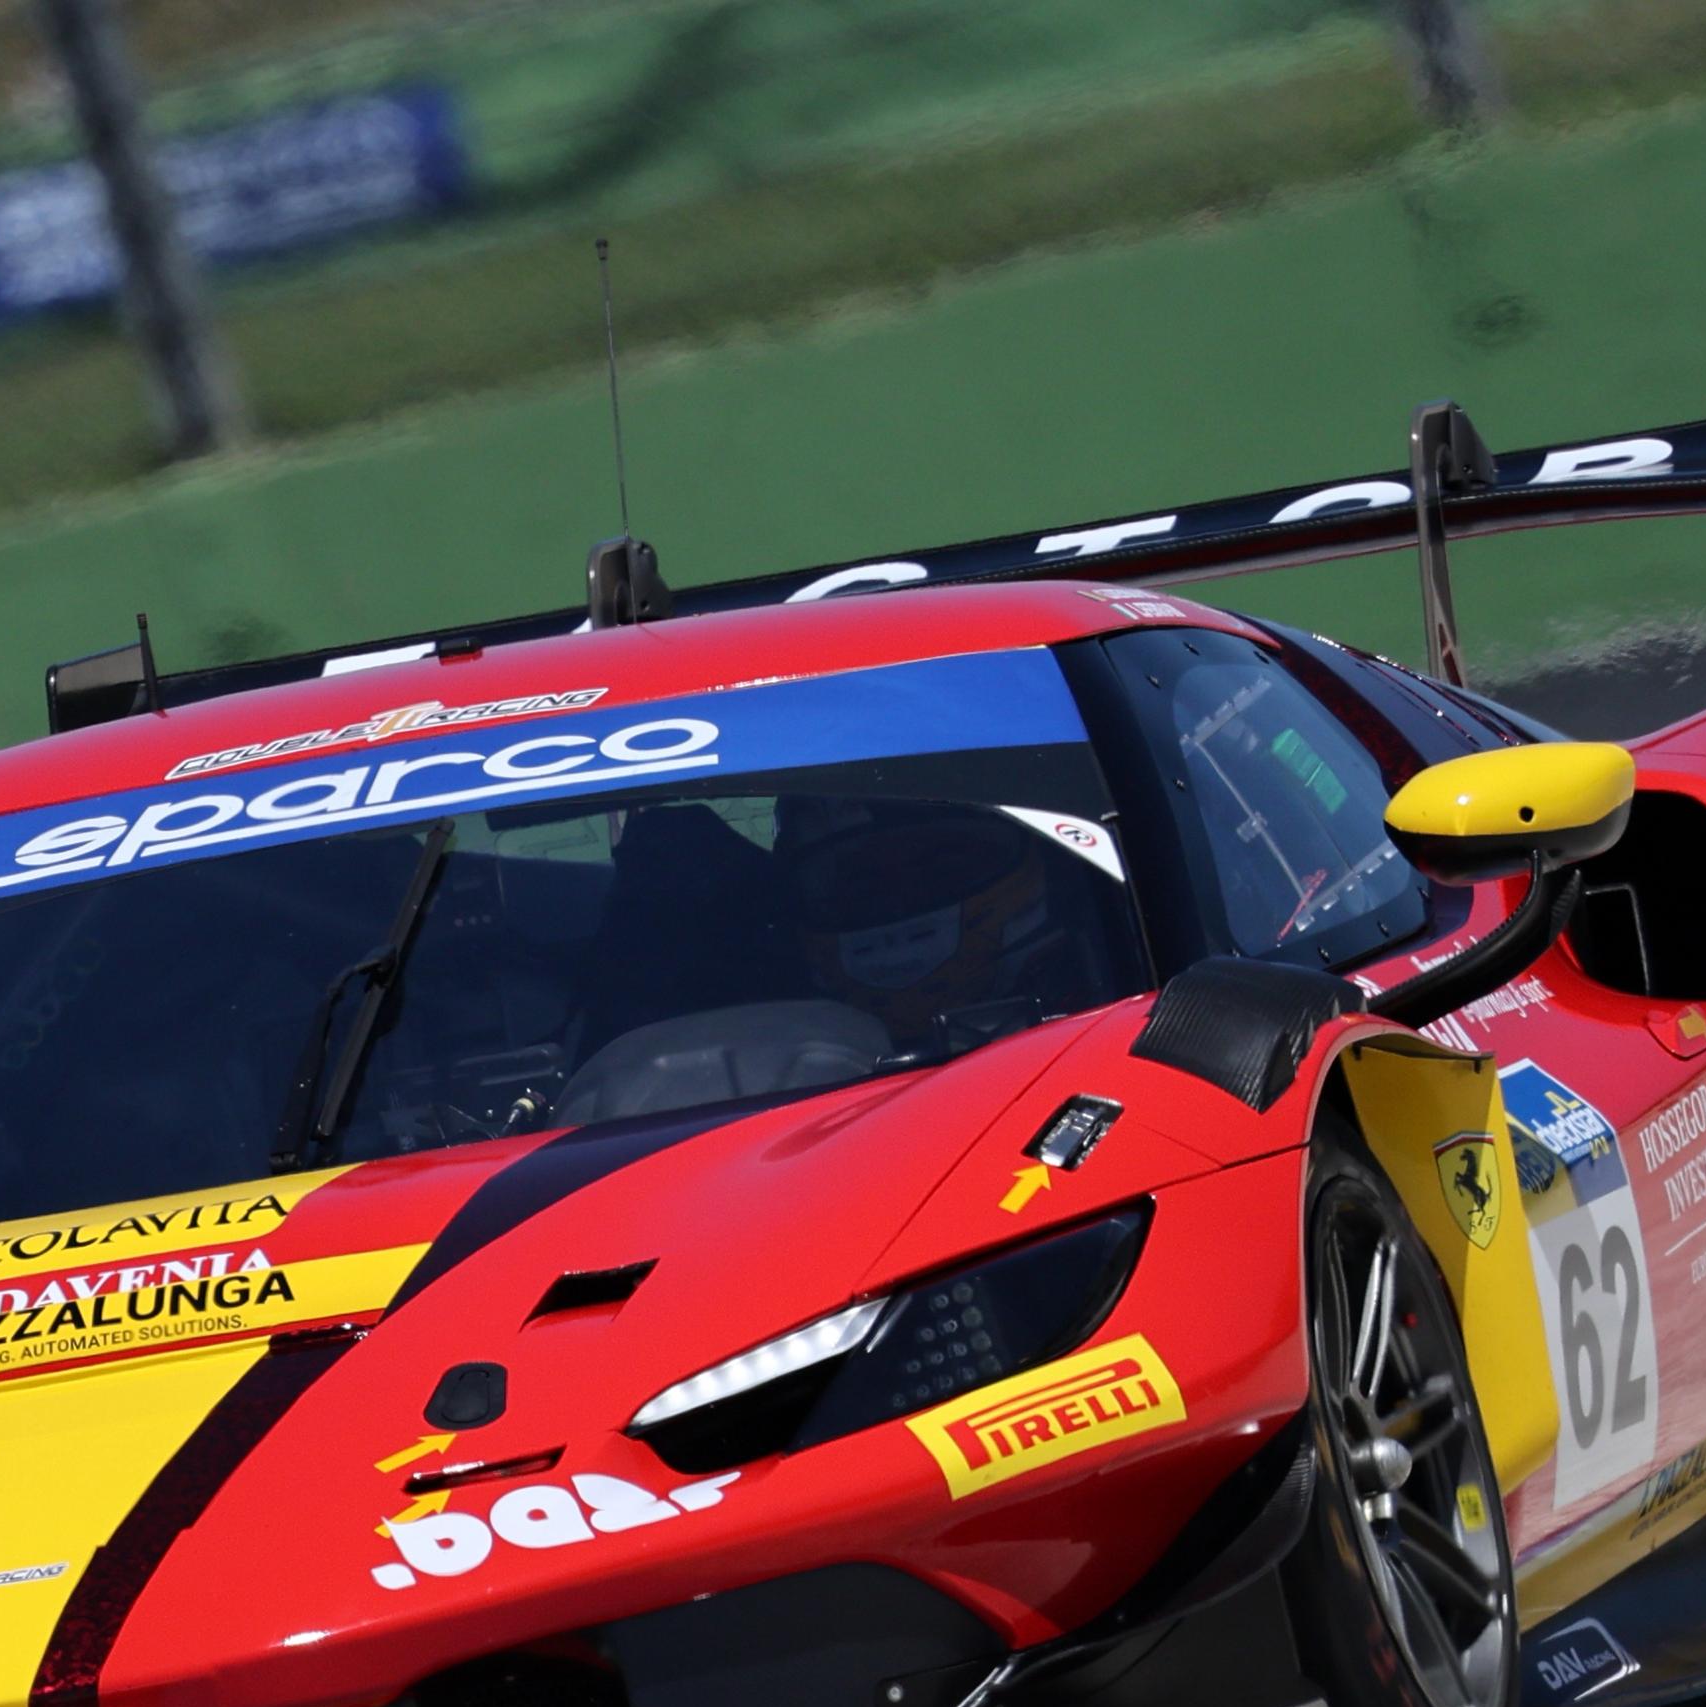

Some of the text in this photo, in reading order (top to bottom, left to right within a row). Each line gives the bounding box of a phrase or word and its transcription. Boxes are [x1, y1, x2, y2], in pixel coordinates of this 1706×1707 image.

[13, 718, 719, 868] sparco
[19, 1329, 134, 1362] AUTOMATED
[137, 1314, 249, 1343] SOLUTIONS.
[1559, 1225, 1647, 1449] 62
[943, 1358, 1161, 1472] PIRELLI
[1537, 1647, 1587, 1691] DAV
